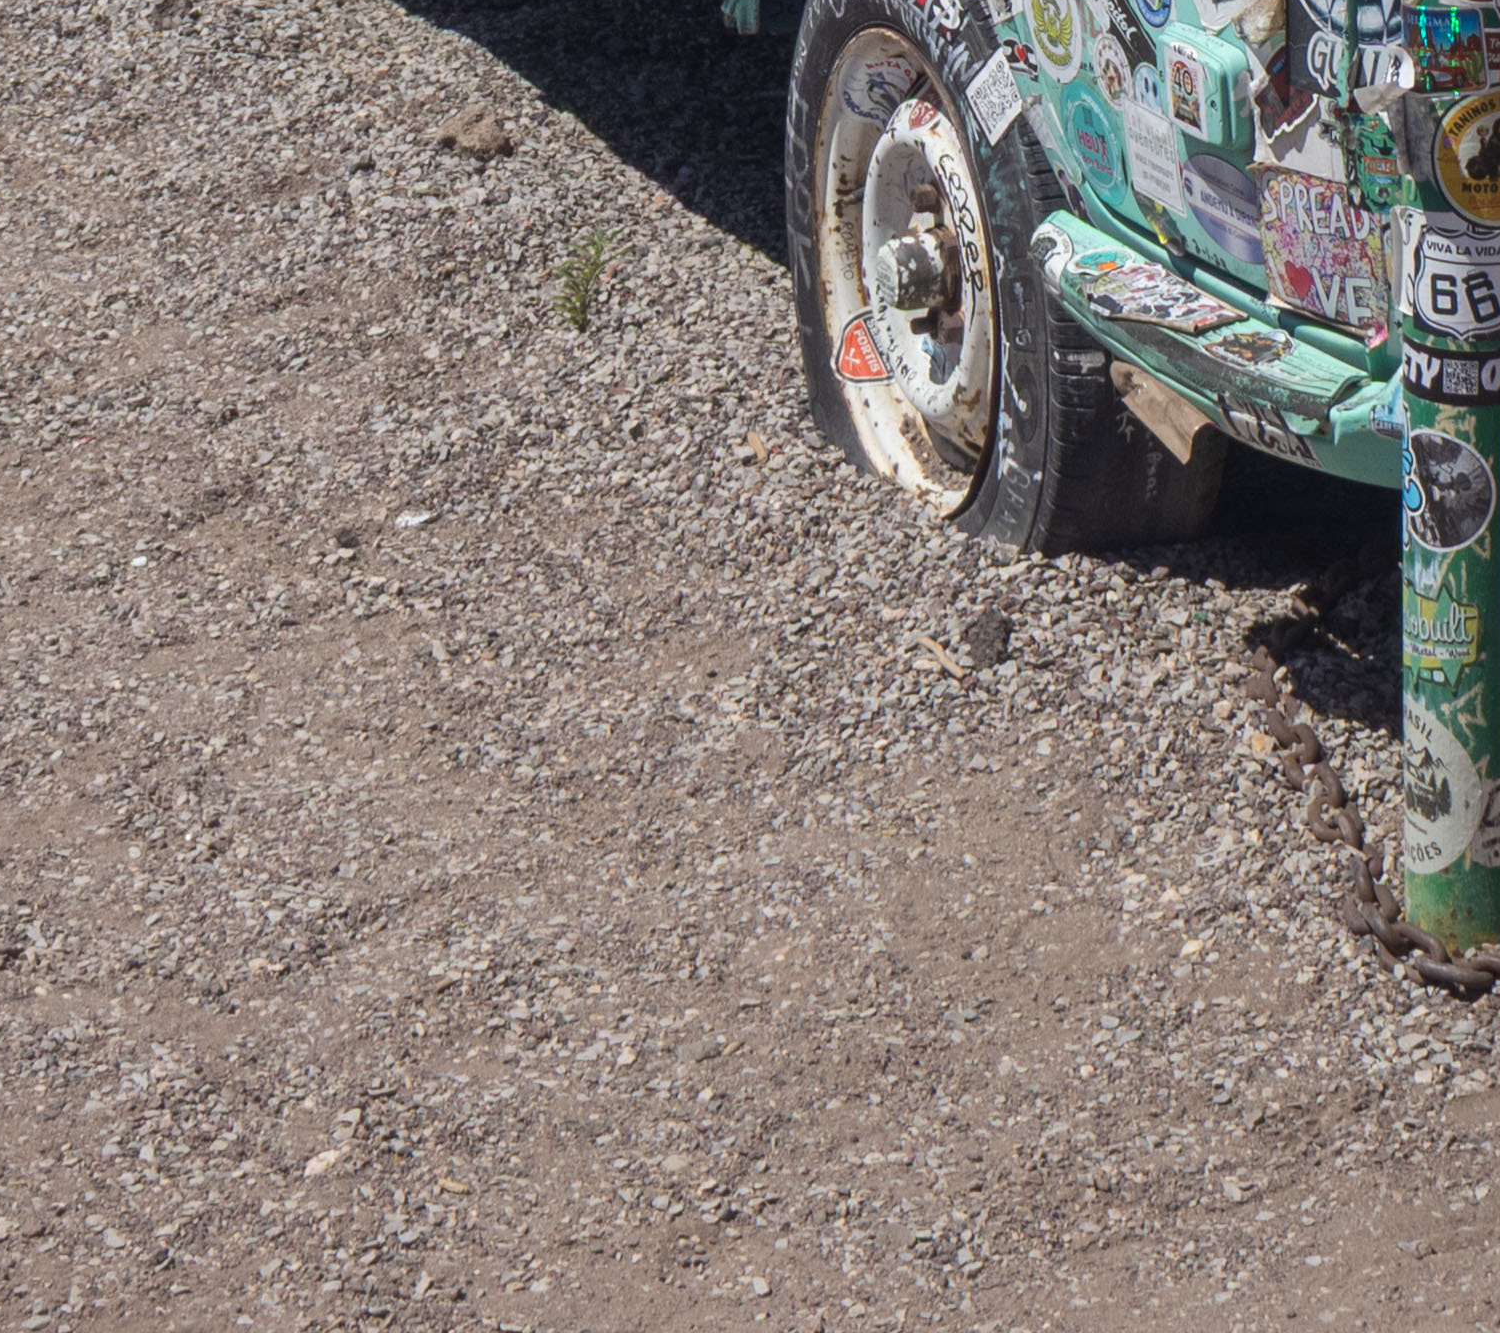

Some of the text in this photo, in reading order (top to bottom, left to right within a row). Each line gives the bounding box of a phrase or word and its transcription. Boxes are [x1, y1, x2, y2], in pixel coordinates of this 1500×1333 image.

[1460, 180, 1496, 194] MOTO
[1263, 182, 1372, 240] SPREAD
[1426, 240, 1453, 255] VIVA
[1456, 243, 1470, 256] LA
[1431, 271, 1500, 324] 66
